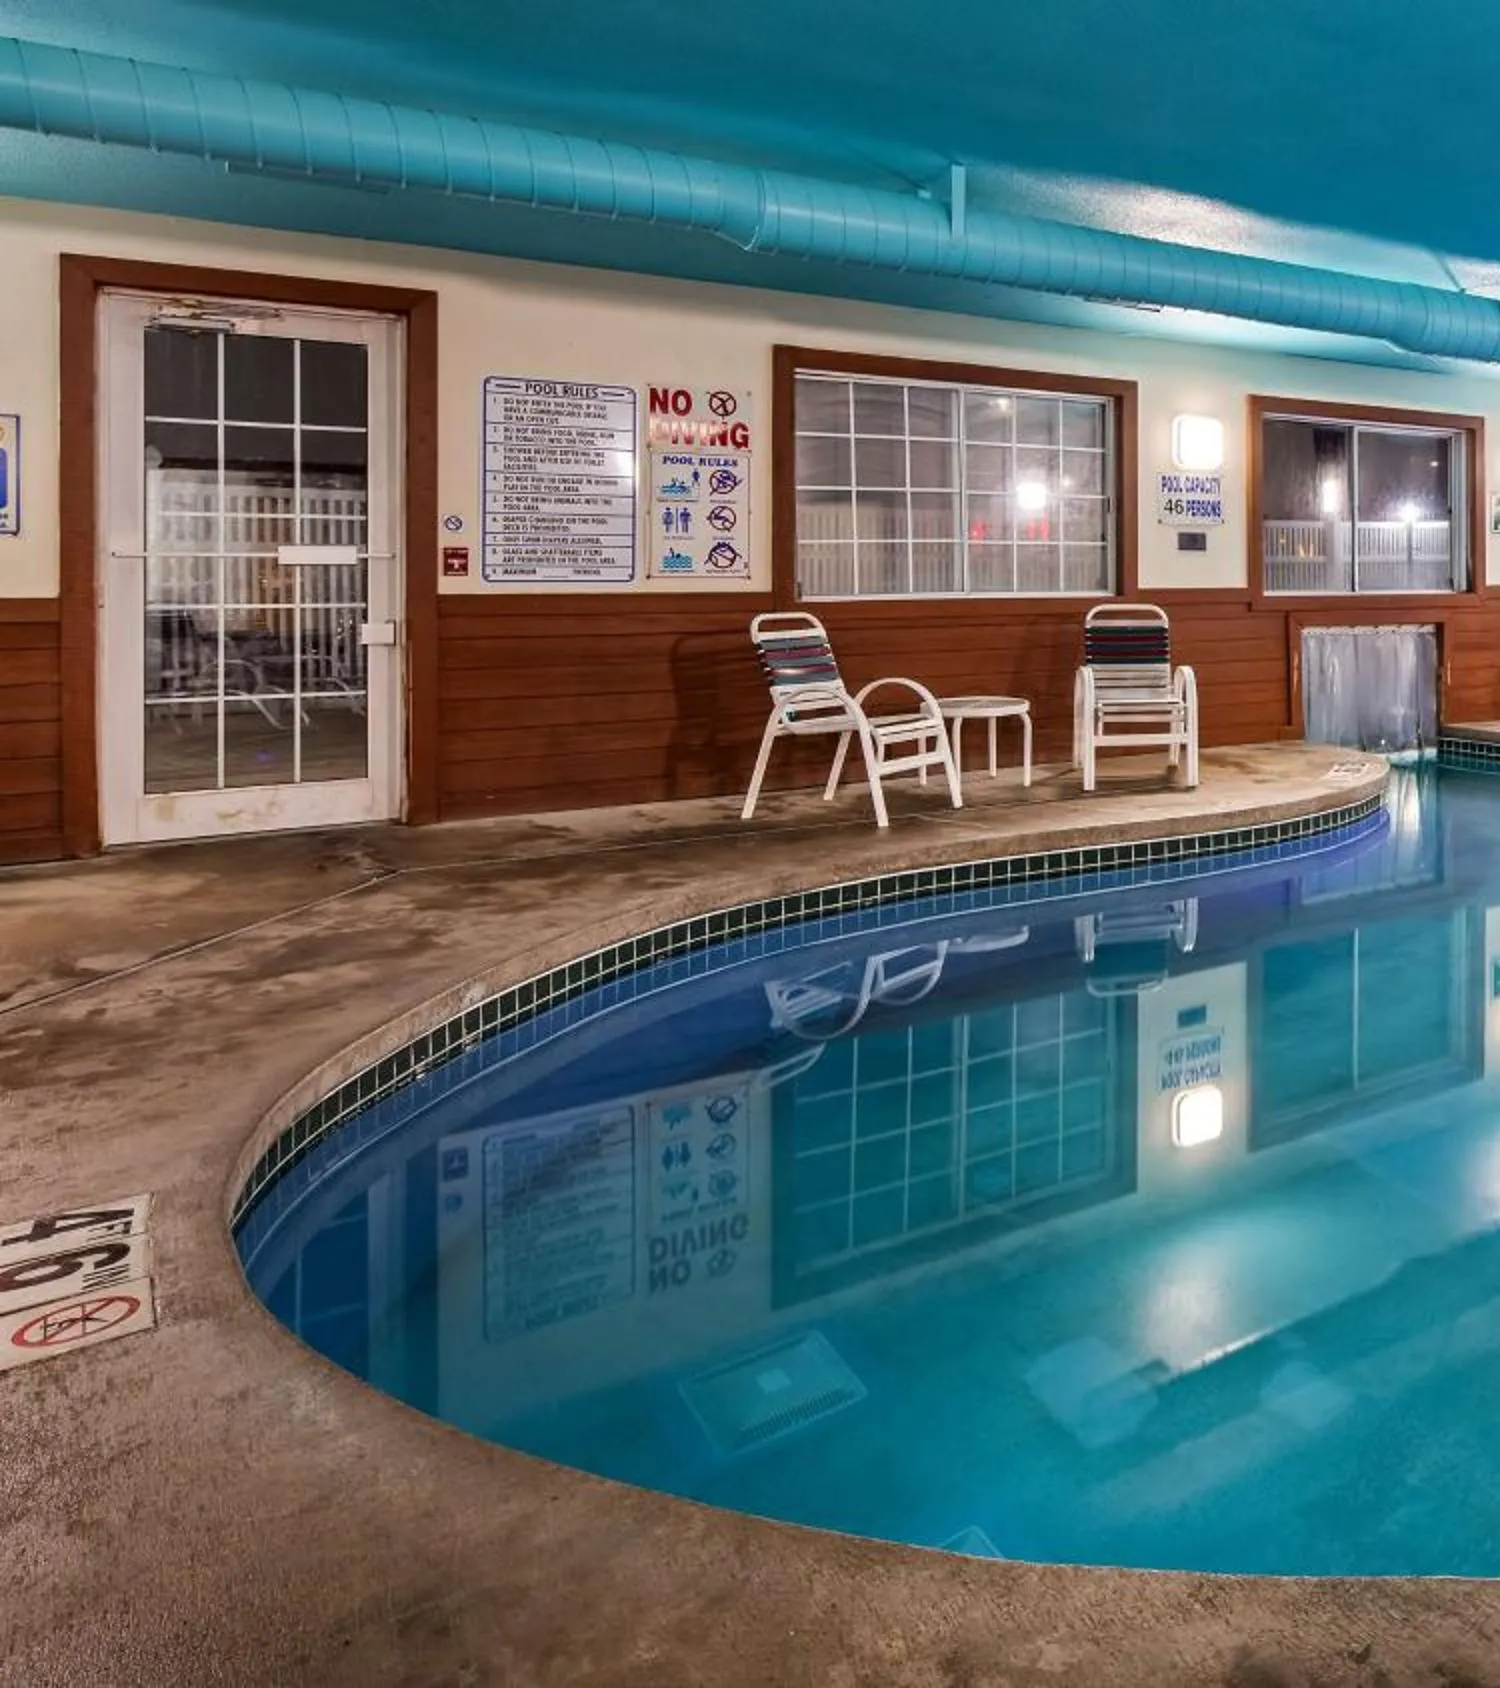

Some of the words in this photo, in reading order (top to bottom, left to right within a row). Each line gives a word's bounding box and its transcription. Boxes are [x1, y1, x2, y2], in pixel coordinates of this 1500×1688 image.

[525, 383, 557, 396] POOL
[562, 386, 599, 398] RULES
[649, 387, 692, 416] NO
[663, 455, 694, 466] POOL
[699, 457, 738, 467] RULES
[1161, 475, 1183, 493] POOL
[1185, 475, 1221, 496] CAPACITY
[1163, 499, 1184, 516] 46
[1186, 499, 1222, 518] PERSONS
